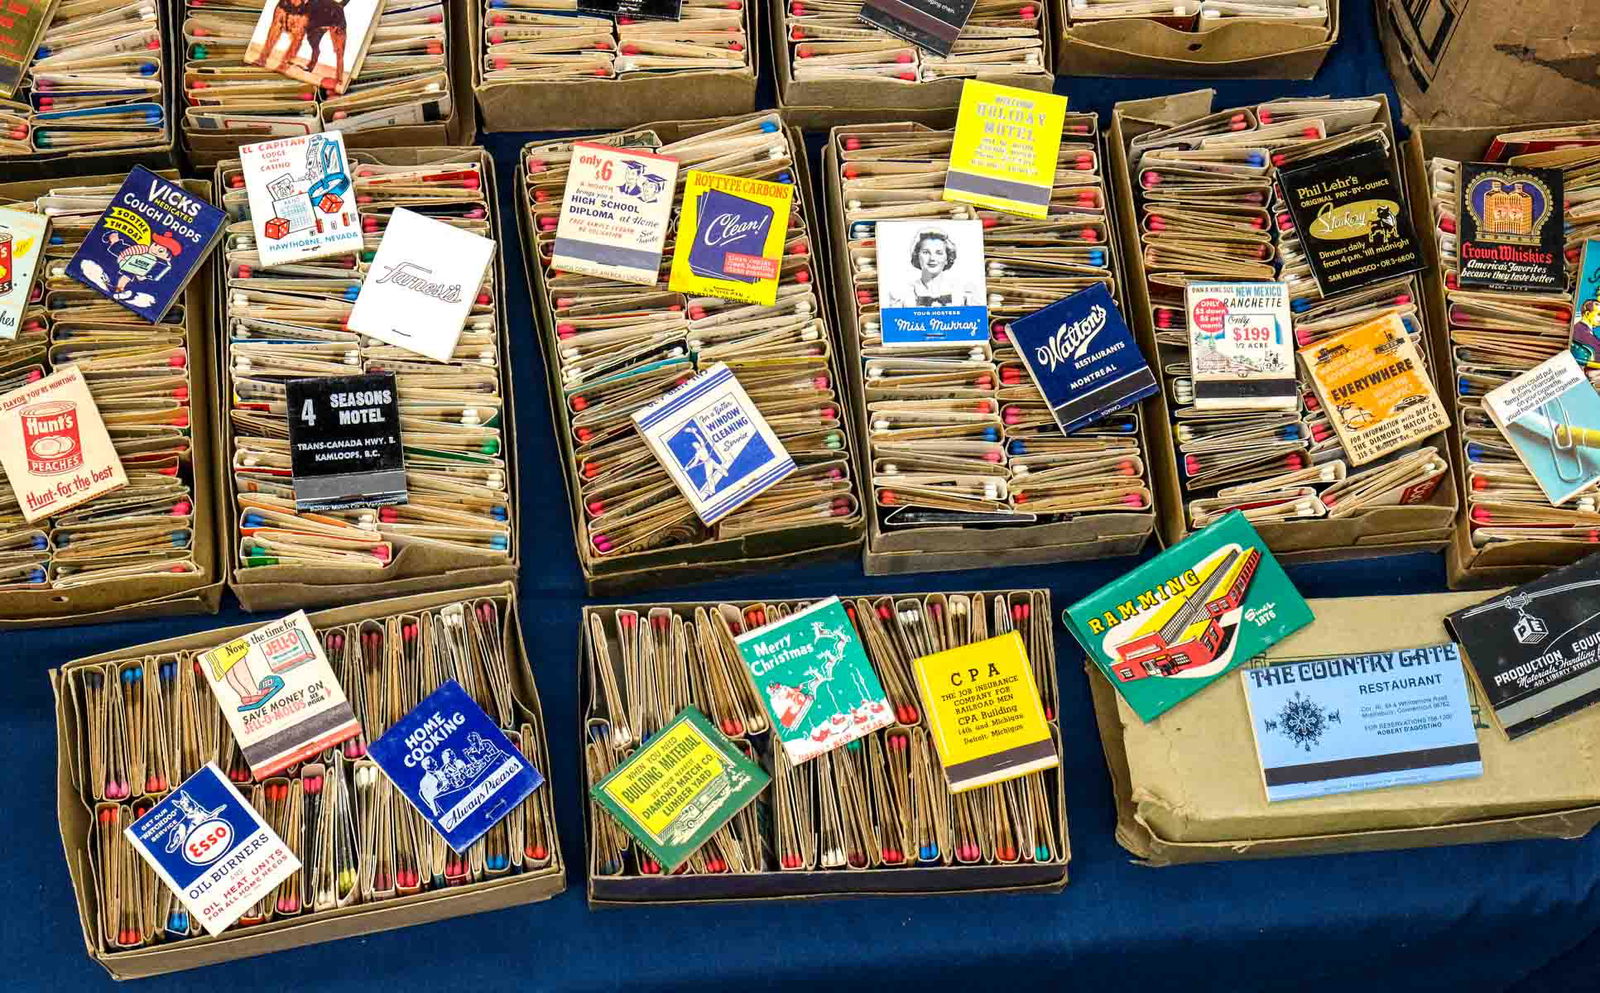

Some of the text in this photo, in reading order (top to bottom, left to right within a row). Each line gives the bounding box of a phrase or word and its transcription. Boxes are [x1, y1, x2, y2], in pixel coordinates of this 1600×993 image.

[977, 104, 1046, 126] HOLIDAY
[984, 122, 1035, 141] MOTEL
[258, 138, 305, 151] CAPITAN
[260, 162, 291, 172] CASINO
[580, 154, 602, 168] only
[147, 179, 202, 217] VICKS
[743, 181, 790, 199] CARBONS
[1297, 176, 1359, 200] Phil Lehr's
[154, 198, 193, 224] MEDICATED
[571, 195, 640, 214] HIGH SCHOOL
[1300, 194, 1333, 208] ORIGINAL
[116, 209, 149, 235] SOOTHE
[124, 192, 202, 243] COUGH DROPS
[569, 206, 631, 224] DIPLOMA at
[109, 219, 144, 242] THROAT
[325, 232, 359, 243] NEVADA
[705, 213, 768, 246] Clean!
[1319, 241, 1366, 260] Dinners daily
[1322, 238, 1410, 269] from midnight
[1462, 242, 1553, 264] Crown Whiskies
[1327, 264, 1377, 283] SAN FRANCISCO
[1461, 269, 1555, 283] because they taste better
[1467, 260, 1547, 273] America's Favorites
[1223, 297, 1283, 308] RANCHETTE
[1235, 286, 1282, 297] NEW MEXICO
[1228, 315, 1251, 327] Only
[1233, 327, 1270, 341] $199
[1074, 341, 1125, 369] RESTAURANTS
[1070, 364, 1117, 390] MONTREAL
[1331, 358, 1414, 402] EVERYWHERE
[1515, 368, 1553, 394] you could put
[1531, 374, 1556, 392] charcoal
[3, 375, 77, 409] FLAVOR YOU'RE HUNTING
[1521, 390, 1557, 413] have better
[1524, 391, 1538, 404] your
[301, 390, 392, 426] 4 SEASONS
[339, 408, 385, 425] MOTEL
[706, 407, 741, 432] WINDOW
[26, 415, 74, 435] Hunt's
[711, 416, 749, 443] CLEANING
[1350, 419, 1399, 444] FOR INFORMATION
[1353, 411, 1441, 452] THE DIAMOND MATCH CO.
[297, 438, 387, 451] TRANS-CANADA HWY.
[723, 432, 749, 453] Service
[32, 456, 79, 472] PEACHES
[315, 451, 363, 461] KAMLOOPS,
[74, 465, 113, 491] the best
[1087, 569, 1200, 635] RAMMING
[1244, 602, 1276, 621] Since
[250, 633, 266, 644] the
[263, 626, 285, 639] time
[283, 617, 298, 630] for
[1254, 611, 1277, 628] 1876
[265, 632, 299, 656] JELL-O
[753, 633, 791, 658] Merry
[750, 643, 814, 677] Christmas
[1251, 644, 1457, 688] THE COUNTRY GATE
[1494, 650, 1564, 687] PRODUCTION
[1516, 649, 1597, 689] Materials Handling
[940, 674, 1019, 702] THE JOB INSURANCE
[1359, 673, 1443, 695] RESTAURANT
[1546, 669, 1571, 684] LIBERTY
[242, 680, 325, 725] SAVE MONEY ON
[307, 696, 325, 707] INSIDE
[953, 686, 1011, 707] COMPANY FOR
[954, 693, 1014, 715] RAILROAD MEN
[957, 703, 1018, 726] CPA Building
[957, 713, 1025, 736] 14th and Michigan
[1364, 717, 1427, 732] FOR RESERVATIONS
[403, 711, 466, 768] COOKING
[404, 711, 446, 750] HOME
[832, 733, 853, 748] NEW
[991, 724, 1025, 738] Michigan
[1377, 722, 1442, 736] ROBERT D'AGOSTINO
[621, 764, 664, 804] BUILDING
[658, 733, 702, 773] MATERIAL
[626, 736, 679, 782] WHEN YOU NEED
[675, 758, 696, 781] NEAREST
[445, 762, 521, 830] Always Pleases
[641, 753, 716, 820] DIAMOND MATCH CO.
[662, 768, 713, 818] LUMBER YARD
[141, 809, 168, 831] GET OUR
[150, 820, 178, 842] SERVICE
[188, 826, 227, 858] ESSO
[189, 833, 270, 900] OIL BURNERS
[203, 848, 283, 916] OIL HEAT UNITS
[208, 855, 289, 922] FOR ALL HOME NEEDS
